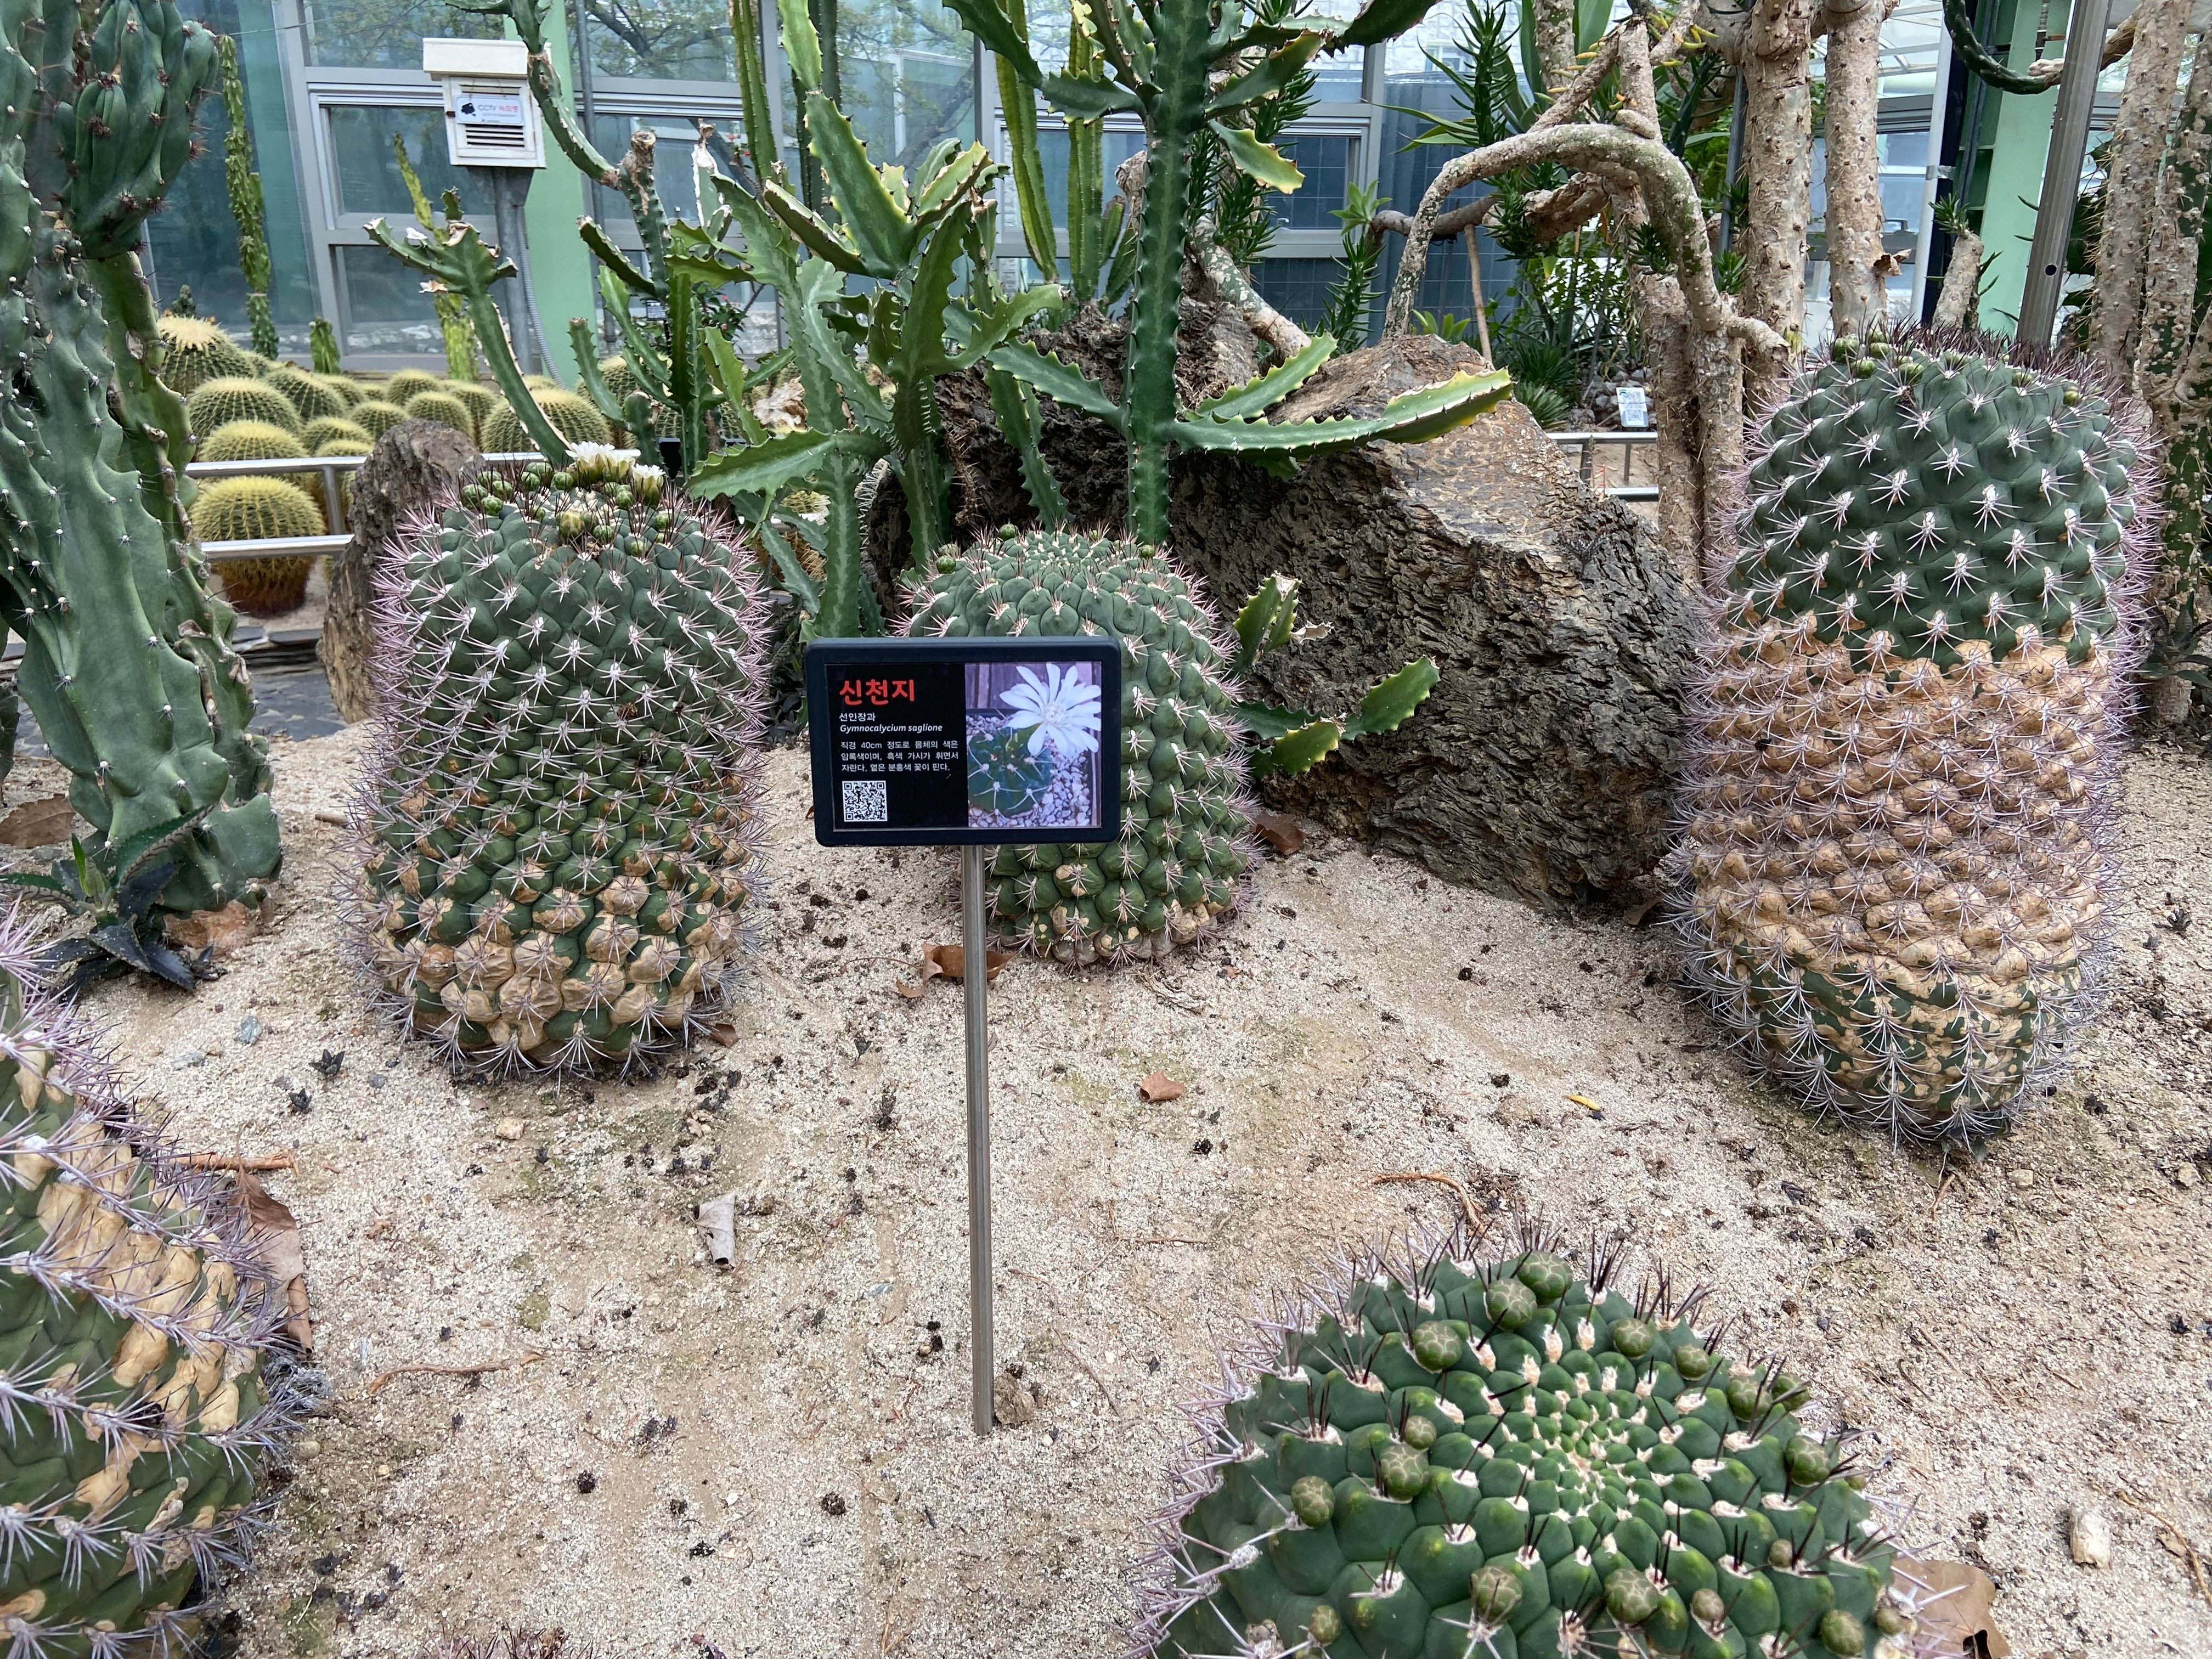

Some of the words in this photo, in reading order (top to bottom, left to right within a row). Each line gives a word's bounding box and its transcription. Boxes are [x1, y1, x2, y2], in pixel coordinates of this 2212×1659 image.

[839, 679, 915, 705] 신천지
[839, 713, 876, 721] 선인장과
[840, 724, 906, 733] Gymnocalycium
[908, 724, 943, 733] saglione
[840, 741, 856, 749] 직경
[887, 741, 910, 749] 정도로
[943, 740, 958, 748] 색은
[887, 752, 902, 760] 흑색
[908, 752, 930, 760] 가시가
[935, 752, 958, 760] 휘면서
[842, 764, 867, 772] 자란다.
[888, 763, 911, 771] 분홍색
[932, 763, 950, 771] 핀다.
